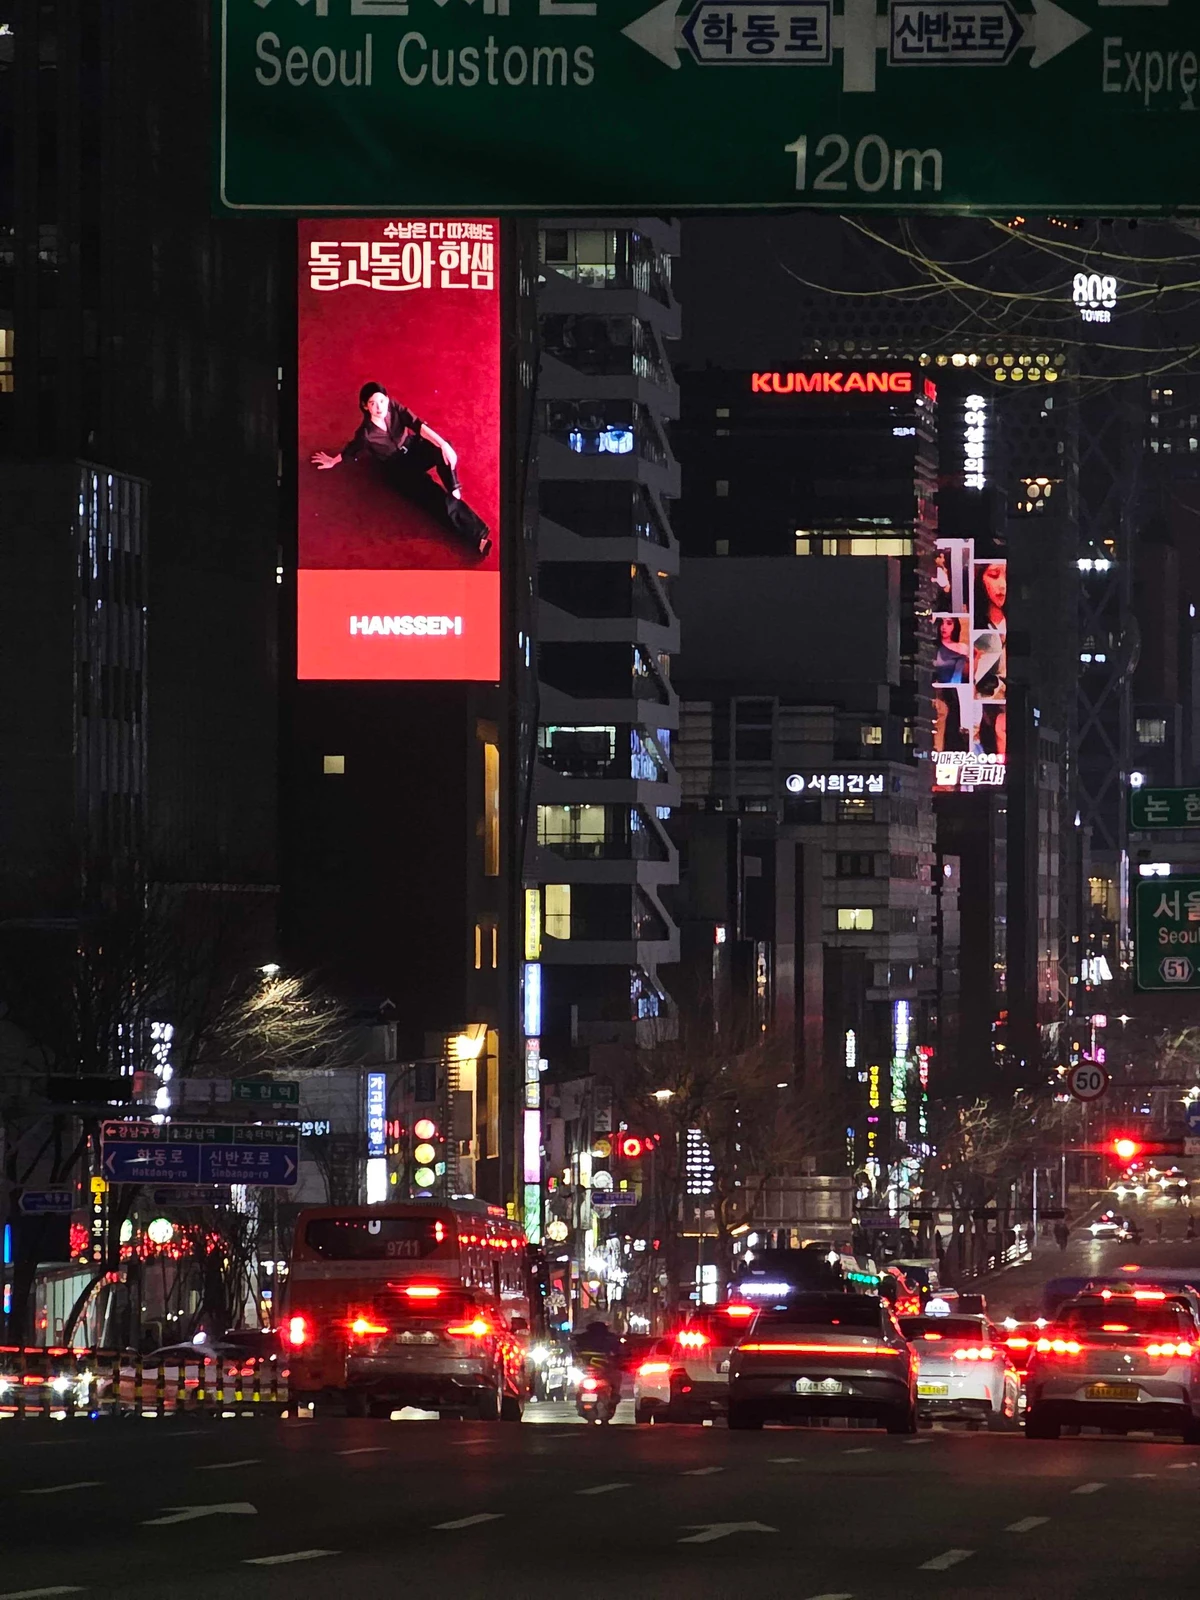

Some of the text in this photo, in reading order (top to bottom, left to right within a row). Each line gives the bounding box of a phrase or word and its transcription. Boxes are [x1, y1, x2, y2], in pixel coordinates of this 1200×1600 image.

[701, 13, 823, 54] 학동로
[896, 11, 1006, 53] 신반포로
[255, 31, 595, 86] Seoul Customs
[784, 134, 943, 192] 120m
[383, 222, 427, 239] 수납은
[430, 223, 445, 239] 다
[308, 241, 494, 291] 돌고돌아 한샘
[1073, 273, 1117, 308] 808
[1080, 309, 1111, 323] TOWER
[751, 372, 912, 392] KUMKANG
[350, 615, 462, 635] HANSSEN
[807, 774, 884, 793] 서희건설
[1168, 961, 1194, 977] 51
[1075, 1071, 1101, 1092] 50
[136, 1149, 185, 1167] 학동로
[209, 1151, 271, 1167] 신반포로
[387, 1241, 420, 1256] 9711
